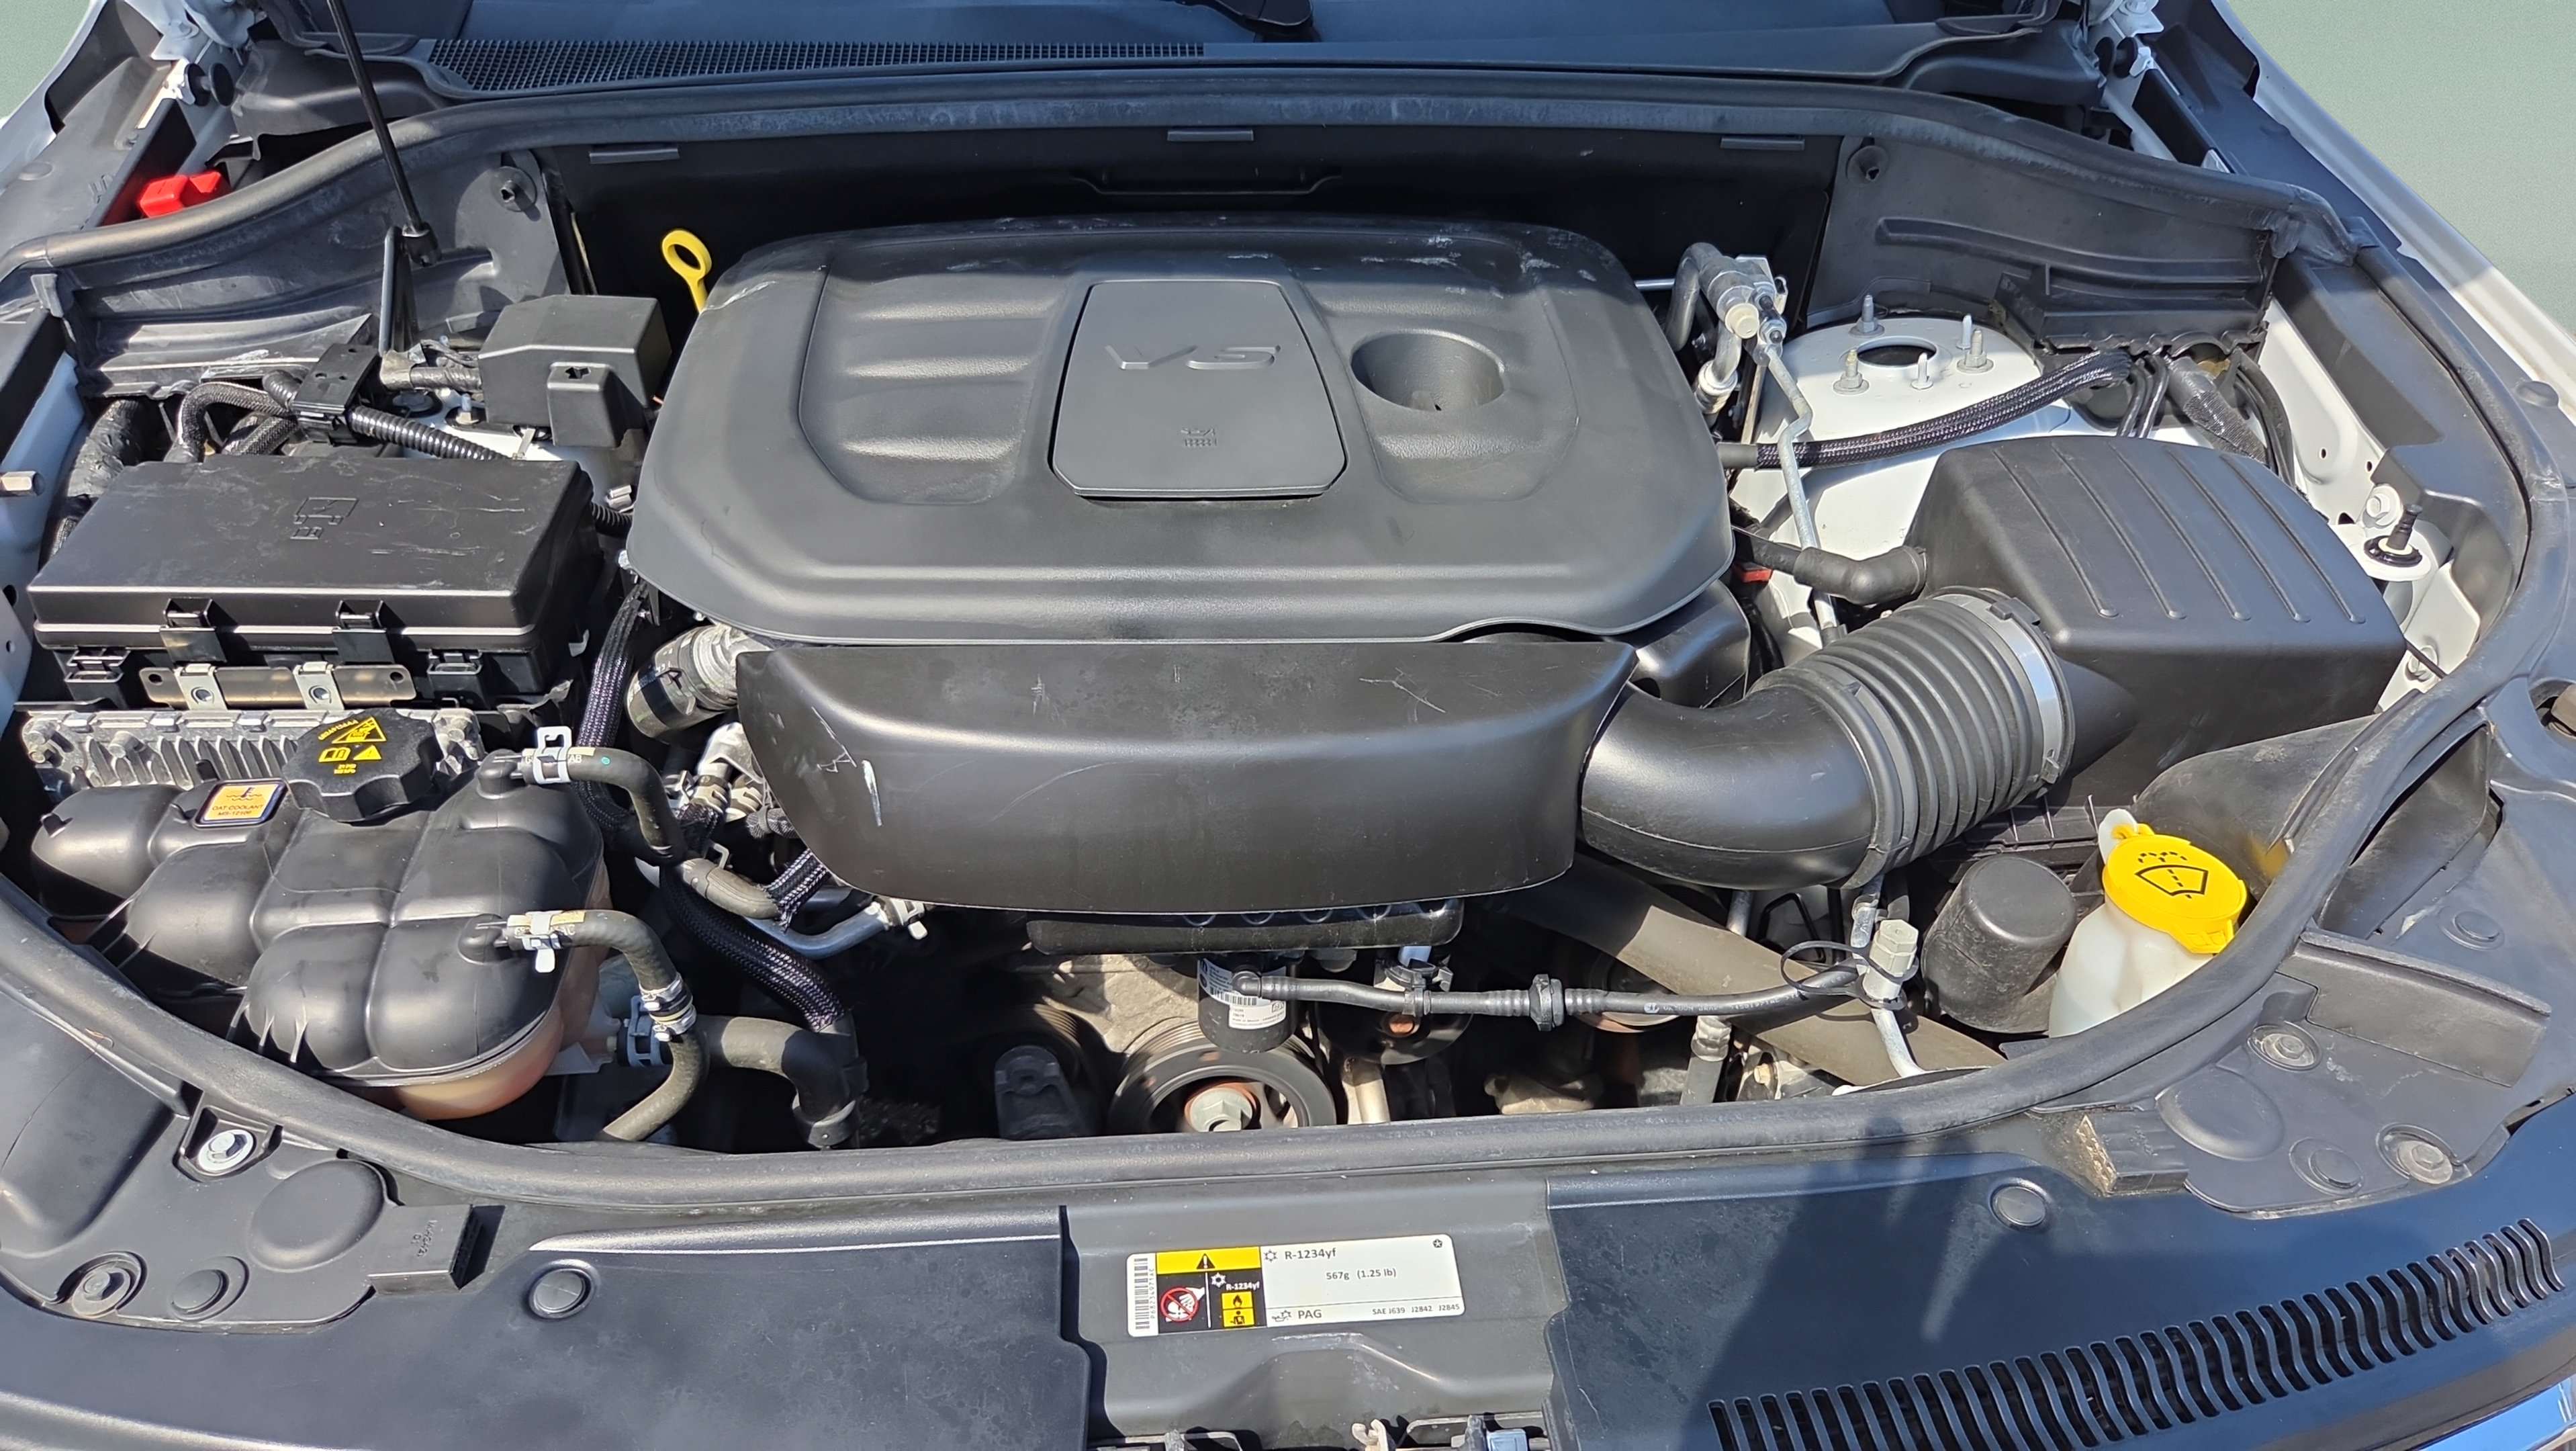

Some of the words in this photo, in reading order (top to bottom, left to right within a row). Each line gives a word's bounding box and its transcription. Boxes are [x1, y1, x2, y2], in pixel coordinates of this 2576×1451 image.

[1285, 1247, 1336, 1260] R-1234yf
[1326, 1271, 1350, 1280] 567g
[1356, 1269, 1381, 1280] (1.25
[1383, 1268, 1397, 1278] lb)
[1226, 1281, 1260, 1291] R-1234yf
[1297, 1309, 1322, 1319] PAG
[1411, 1305, 1432, 1313] J2842
